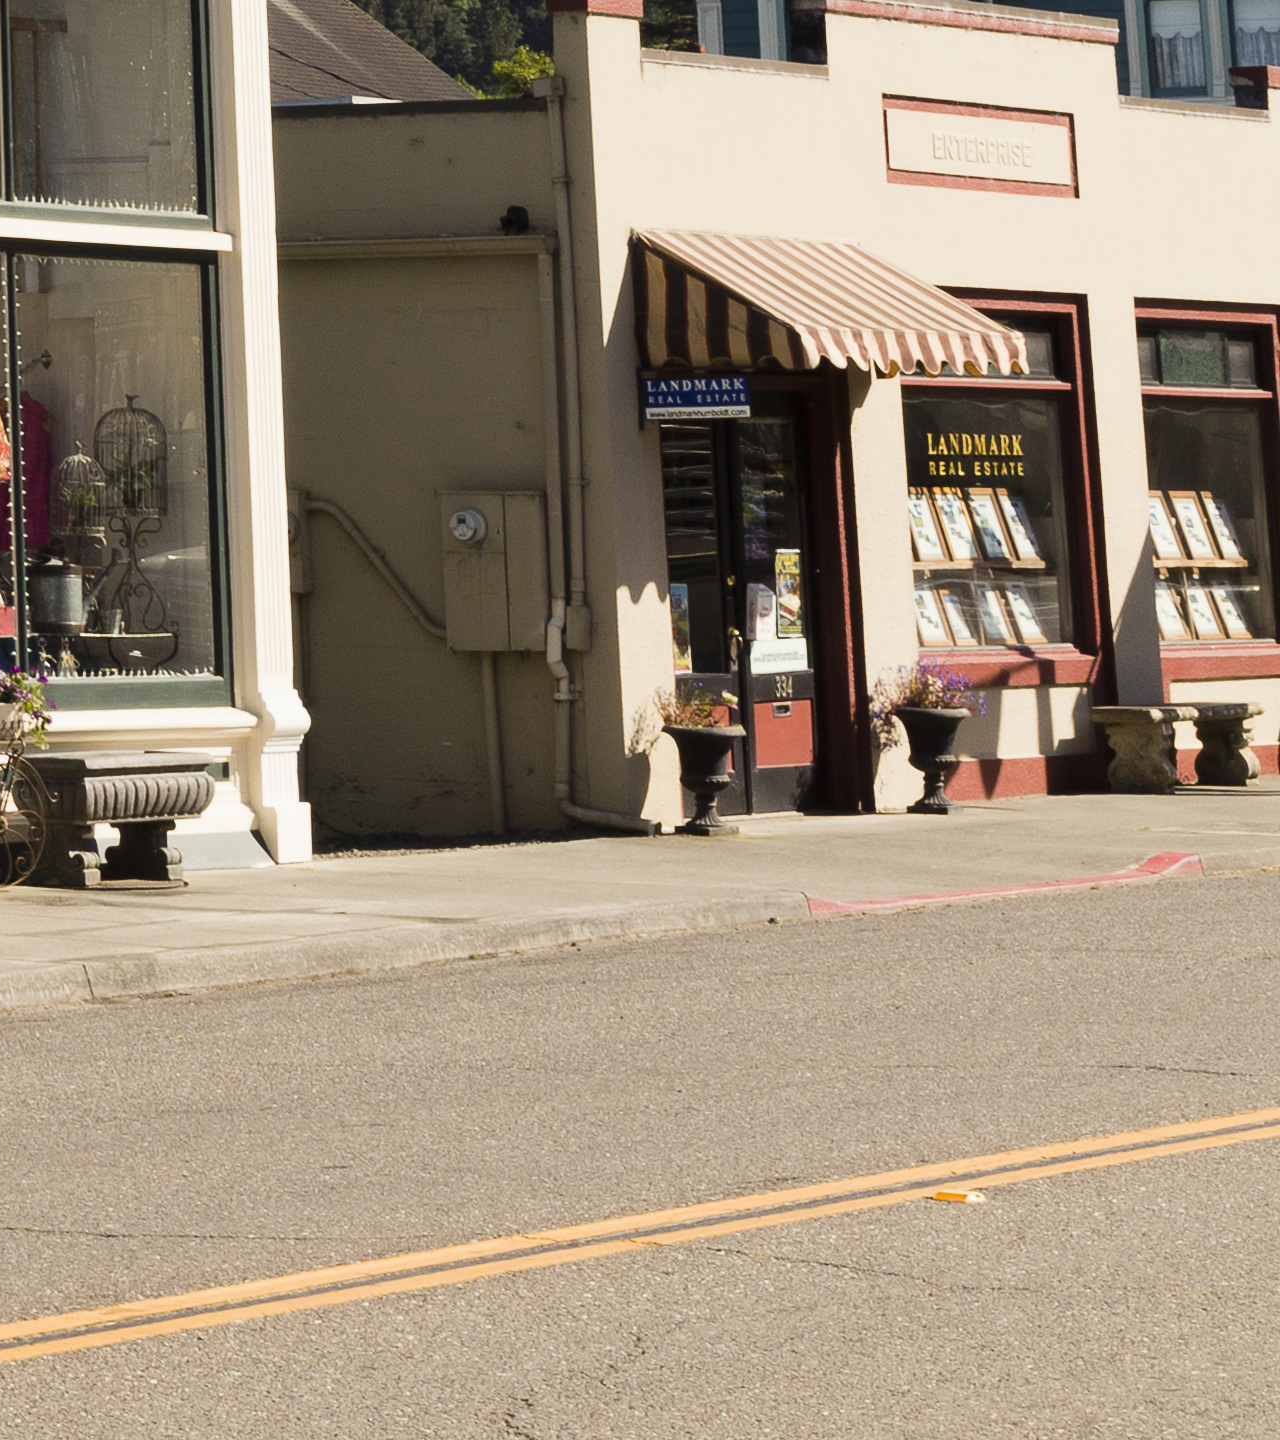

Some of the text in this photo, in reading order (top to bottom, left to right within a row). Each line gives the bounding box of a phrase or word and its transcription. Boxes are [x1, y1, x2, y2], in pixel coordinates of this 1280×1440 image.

[931, 132, 1033, 168] ENTERPRISE
[646, 378, 744, 392] LANDMARK
[648, 393, 746, 404] REAL ESTATE
[926, 433, 1024, 456] LANDMARK
[929, 461, 1025, 476] REAL ESTATE
[775, 675, 793, 698] 334
